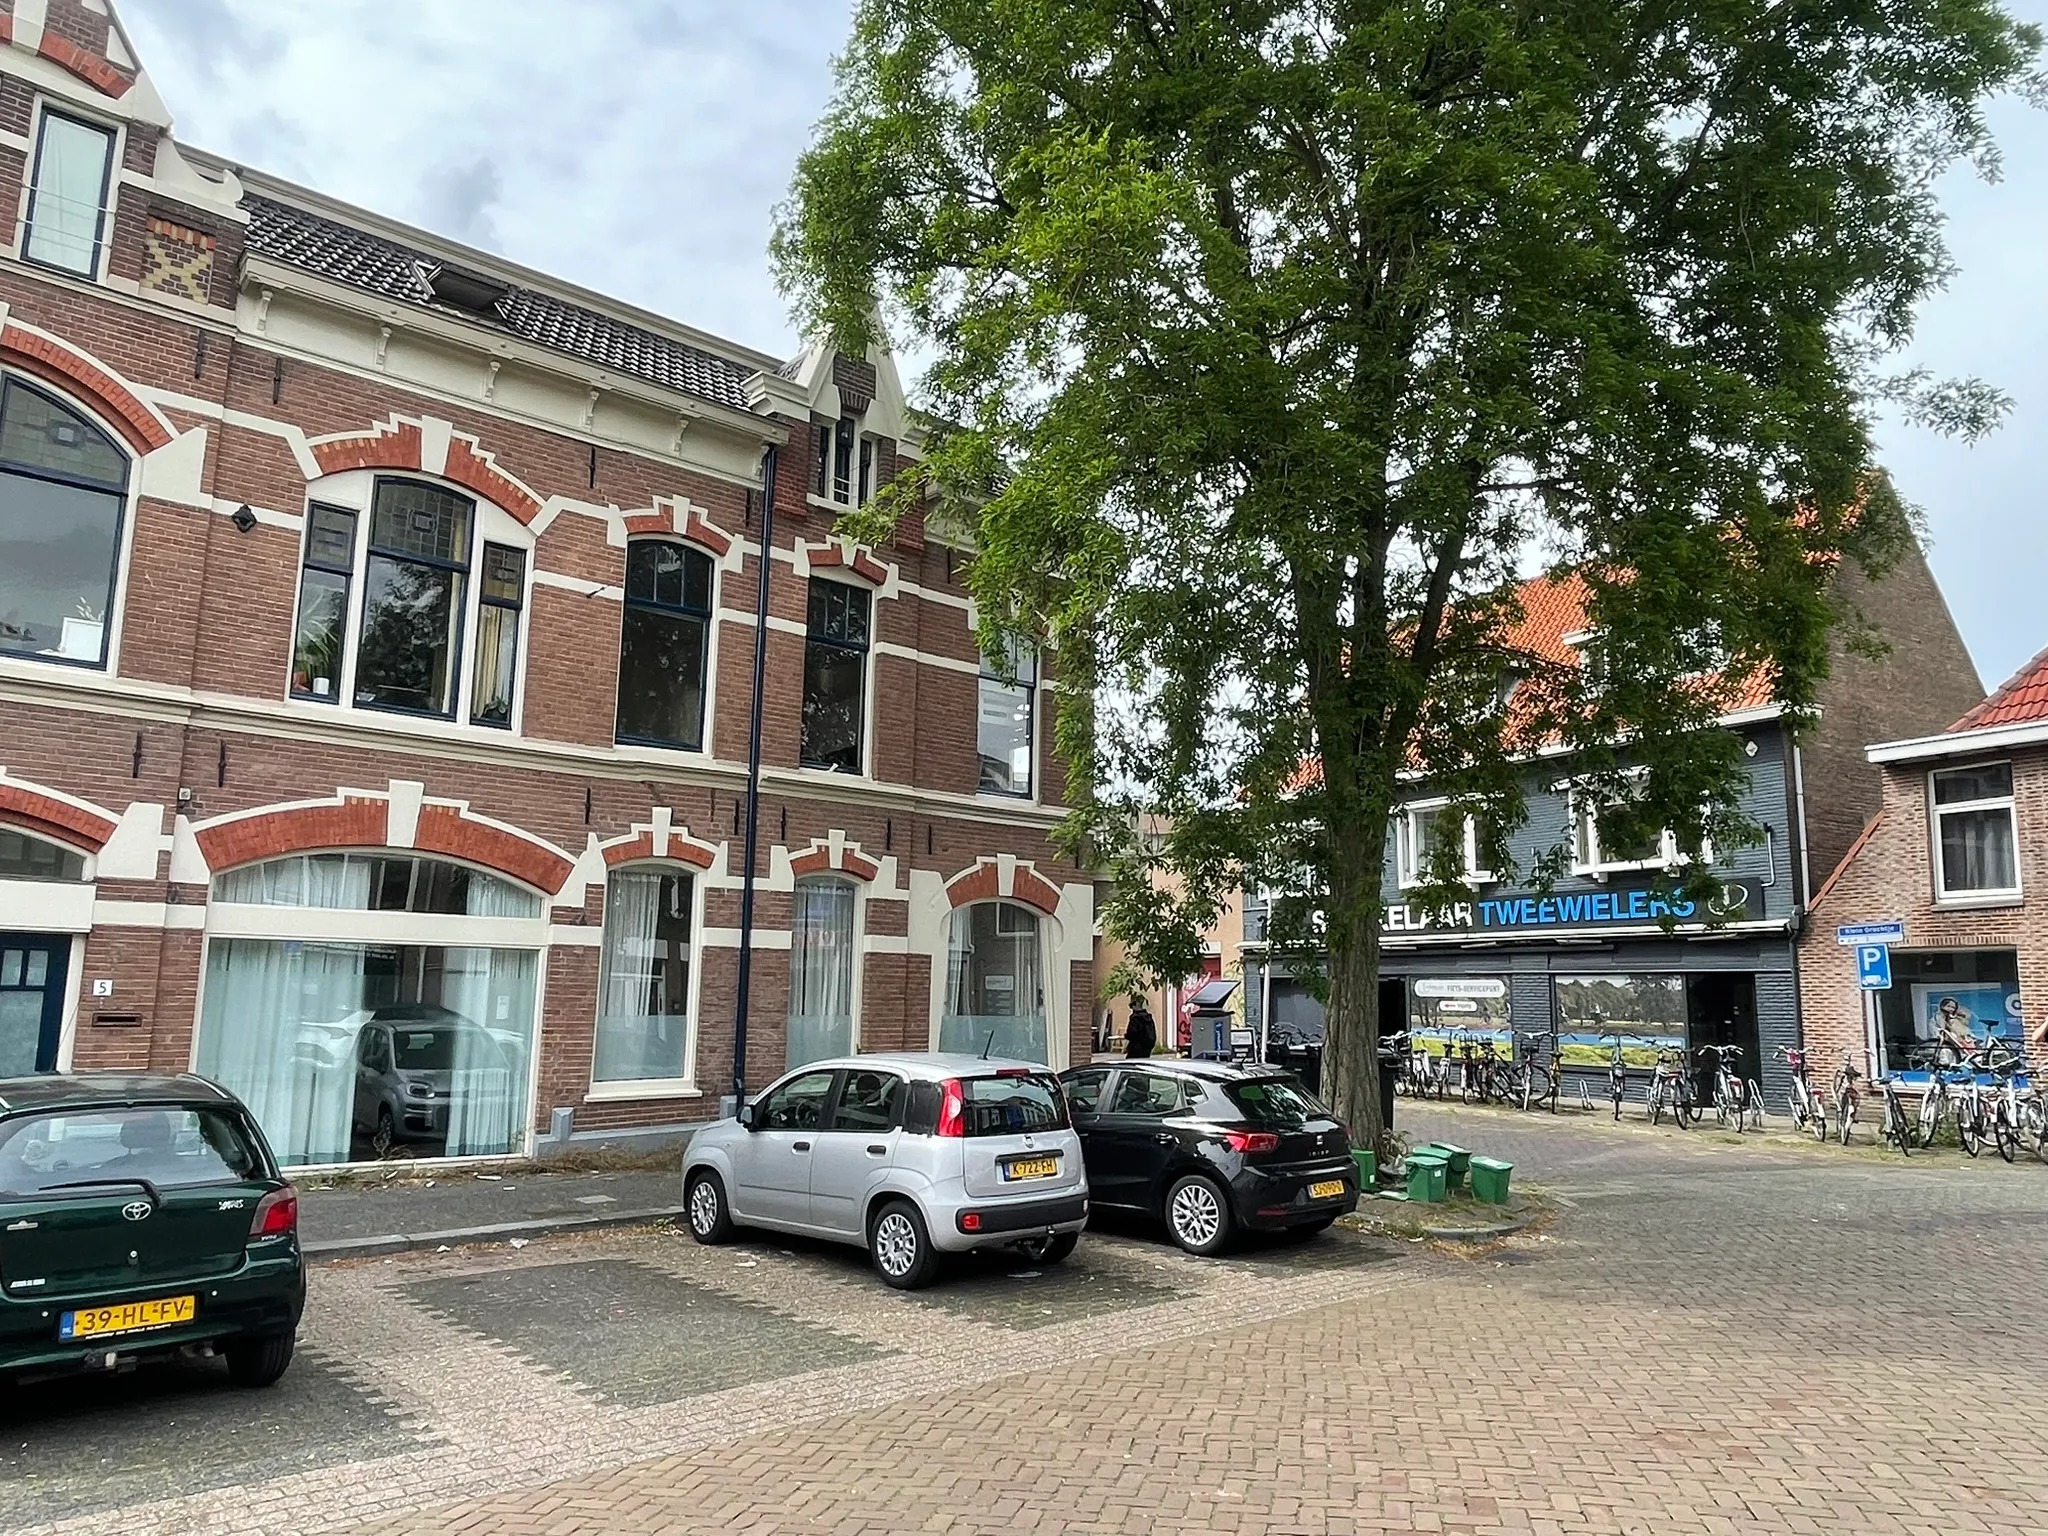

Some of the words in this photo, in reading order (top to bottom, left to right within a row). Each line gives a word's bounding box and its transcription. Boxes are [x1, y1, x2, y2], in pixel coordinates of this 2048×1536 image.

[1862, 948, 1881, 971] P
[98, 981, 107, 995] 5
[83, 1300, 187, 1331] 39-HL-FV
